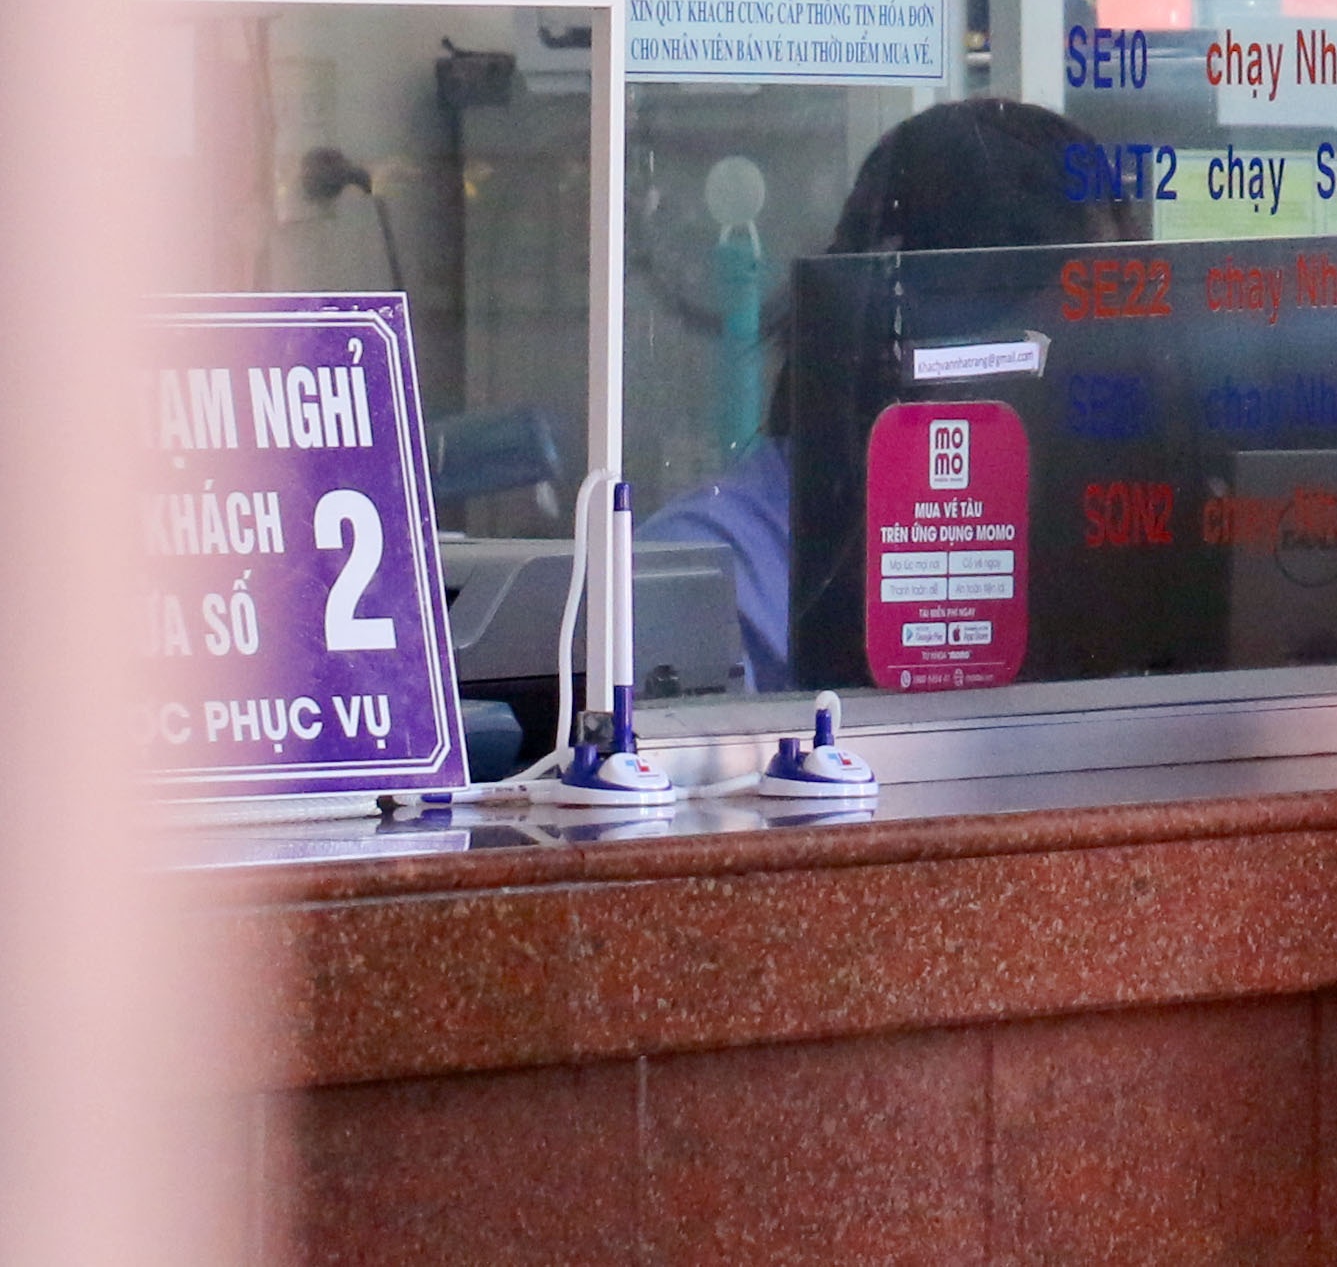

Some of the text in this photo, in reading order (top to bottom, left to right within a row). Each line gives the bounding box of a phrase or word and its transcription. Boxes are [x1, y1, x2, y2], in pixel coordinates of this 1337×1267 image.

[1064, 142, 1177, 204] SNT2
[1208, 146, 1285, 214] chạy
[249, 337, 373, 449] NGHỈ
[881, 522, 1014, 546] TRÊN ỨNG DỤNG MOMO
[915, 497, 982, 518] MUA VÉ TÀU
[314, 489, 397, 652] 2
[203, 569, 259, 656] SỐ
[204, 695, 391, 753] PHỤC VỤ
